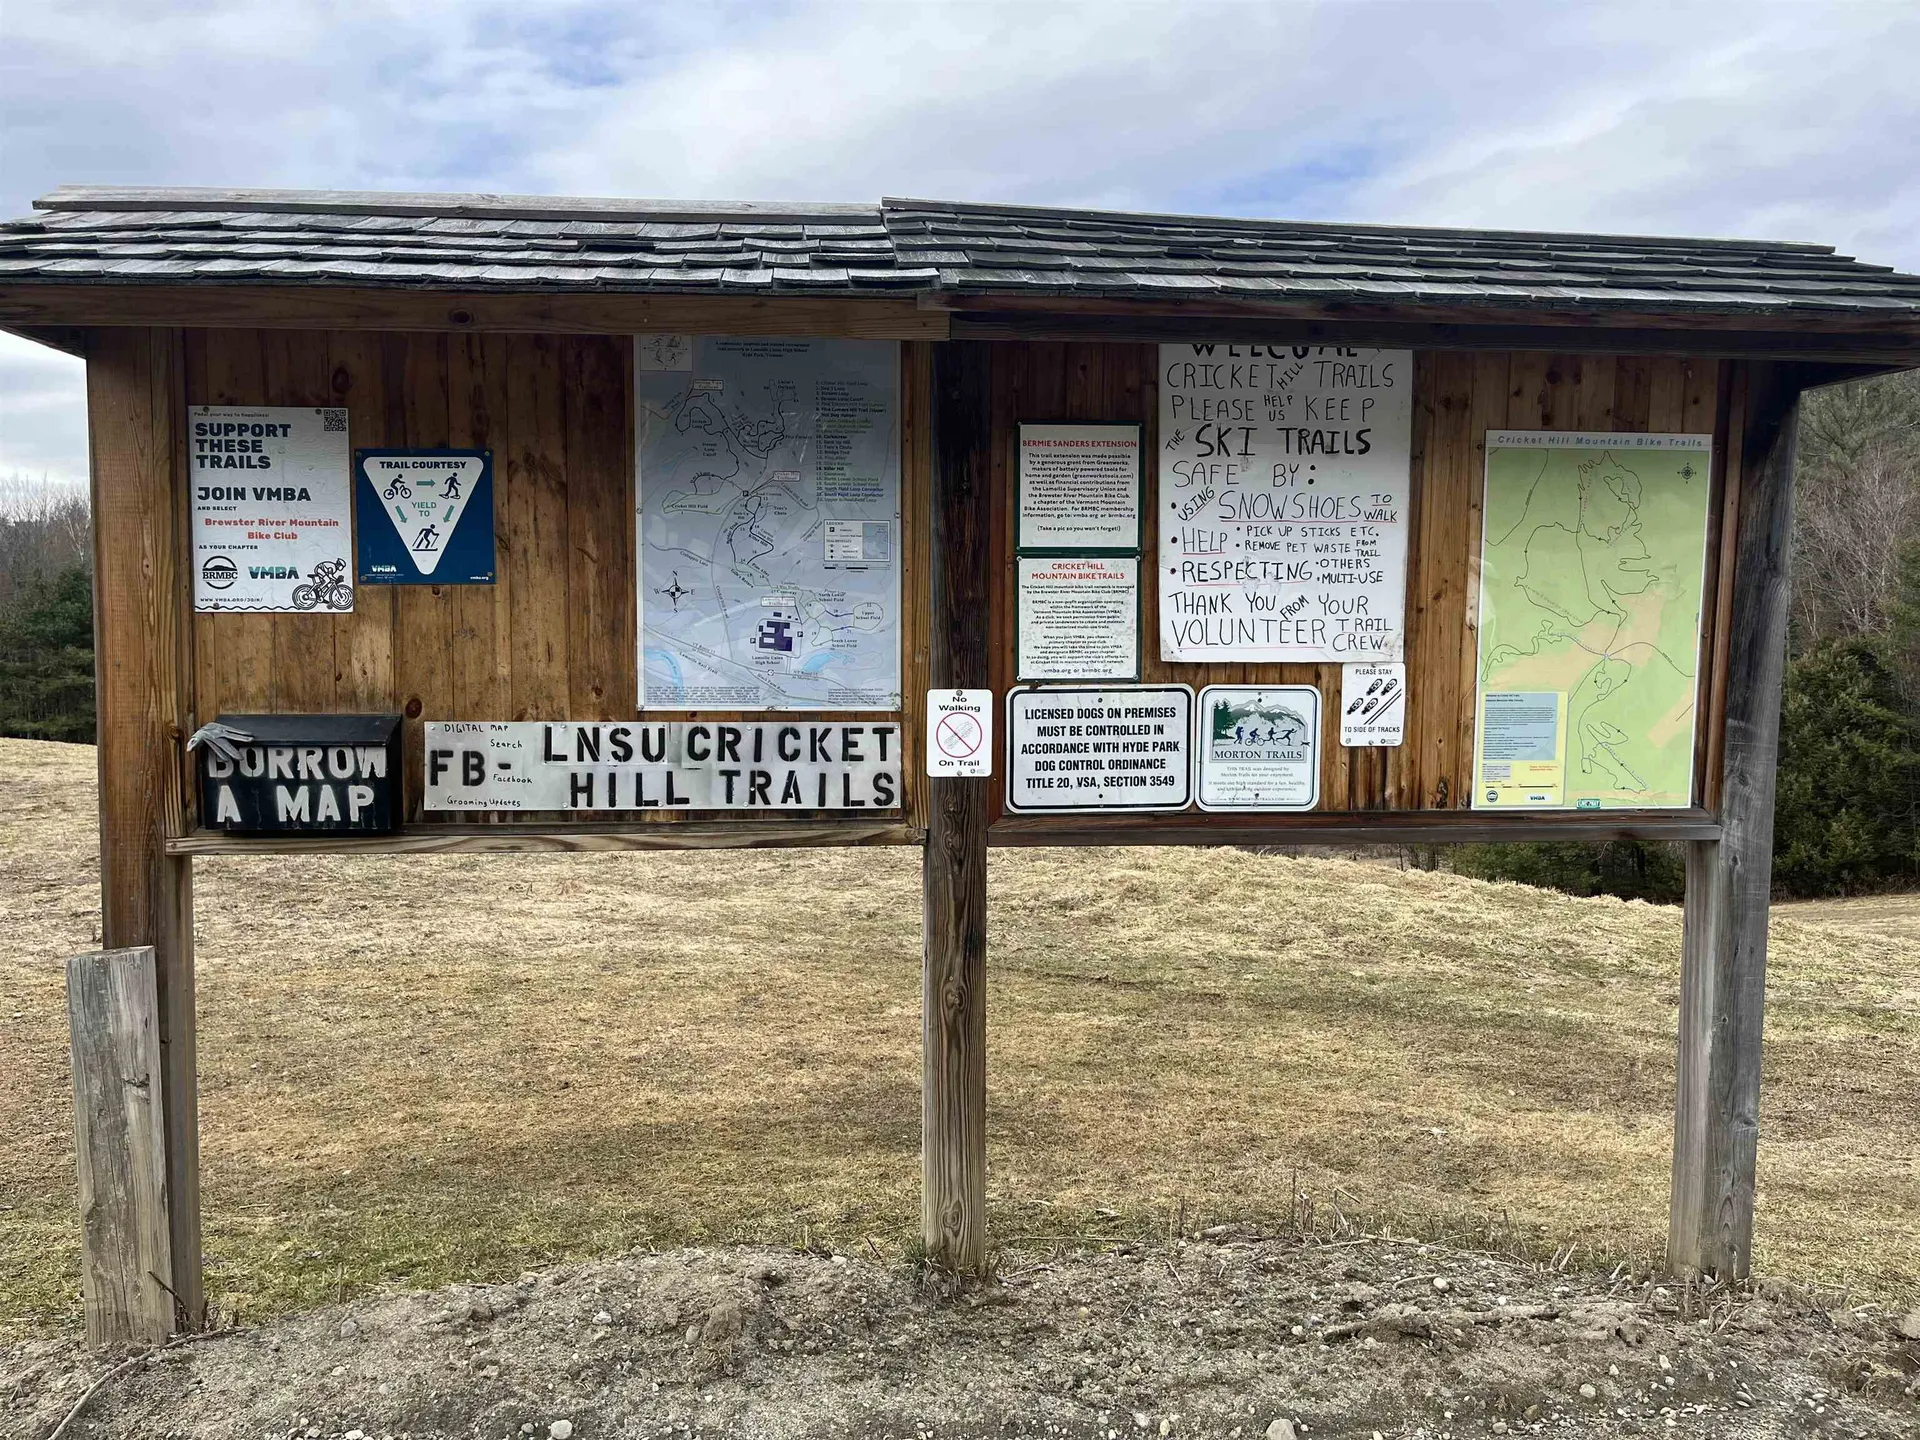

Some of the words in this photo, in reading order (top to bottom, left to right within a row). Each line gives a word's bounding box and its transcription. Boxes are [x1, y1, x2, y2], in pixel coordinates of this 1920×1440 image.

[1167, 363, 1277, 389] CRICKET
[1277, 363, 1303, 390] HILL
[1313, 361, 1394, 388] TRAILS
[1172, 395, 1254, 421] PLEASE
[1264, 395, 1293, 407] HELP
[1268, 410, 1285, 421] US
[1306, 396, 1374, 422] KEEP
[196, 423, 291, 437] SUPPORT
[196, 439, 263, 453] THESE
[1165, 428, 1185, 451] THE
[1195, 423, 1258, 457] SKI
[1277, 427, 1371, 455] TRAILS
[1498, 436, 1542, 444] Cricket
[1576, 437, 1630, 445] Mountain
[1637, 438, 1662, 446] Bike
[196, 455, 270, 469] TRAILS
[1173, 461, 1239, 487] SAFE
[198, 487, 246, 501] JOIN
[253, 487, 311, 502] VMBA
[1372, 494, 1391, 503] TO
[1178, 486, 1214, 521] USING
[1219, 490, 1361, 520] SNOWSHOES
[205, 518, 255, 526] Brewster
[259, 518, 286, 526] River
[290, 518, 339, 526] Mountain
[1364, 509, 1397, 522] WALK
[1182, 526, 1228, 553] HELP
[1247, 525, 1272, 537] PICK
[1279, 526, 1292, 537] UP
[1301, 525, 1340, 537] STICKS
[1350, 526, 1379, 537] ETC.
[1245, 540, 1280, 551] REMOVE
[1287, 542, 1306, 552] PET
[1314, 543, 1350, 554] WASTE
[1355, 549, 1380, 557] TRAIL
[248, 566, 299, 579] VMBA
[1182, 561, 1312, 582] RESPECTING
[1320, 559, 1370, 569] OTHERS
[1322, 571, 1383, 584] MULTI-USE
[1168, 592, 1232, 615] THANK
[1245, 594, 1276, 613] YOU
[1280, 595, 1309, 620] FROM
[1318, 593, 1368, 615] YOUR
[1336, 618, 1393, 631] TRAIL
[1172, 617, 1326, 647] VOLUNTEER
[1332, 634, 1385, 651] CREW
[1025, 708, 1074, 720] LICENSED
[1078, 708, 1104, 719] DOGS
[1108, 708, 1121, 718] ON
[1125, 707, 1176, 718] PREMISES
[444, 723, 483, 733] DIGITAL
[1038, 726, 1066, 737] MUST
[1070, 725, 1082, 736] BE
[1086, 725, 1151, 736] CONTROLLED
[1154, 724, 1164, 735] IN
[490, 739, 523, 748] Search
[544, 726, 665, 762] LNSU
[687, 726, 894, 762] CRICKET
[1021, 742, 1090, 755] ACCORDANCE
[1093, 742, 1119, 753] WITH
[1123, 742, 1149, 753] HYDE
[1153, 741, 1180, 752] PARK
[1035, 760, 1055, 771] DOG
[1059, 759, 1105, 771] CONTROL
[1109, 759, 1166, 770] ORDINANCE
[493, 774, 533, 784] Facebook
[1026, 778, 1054, 788] TITLE
[1057, 778, 1072, 790] 20,
[1076, 777, 1100, 789] VSA,
[1104, 776, 1147, 787] SECTION
[1150, 776, 1175, 787] 3549
[570, 771, 690, 808] HILL
[719, 770, 894, 807] TRAILS
[217, 785, 242, 822] A
[276, 785, 375, 822] MAP
[446, 796, 487, 808] Grooming
